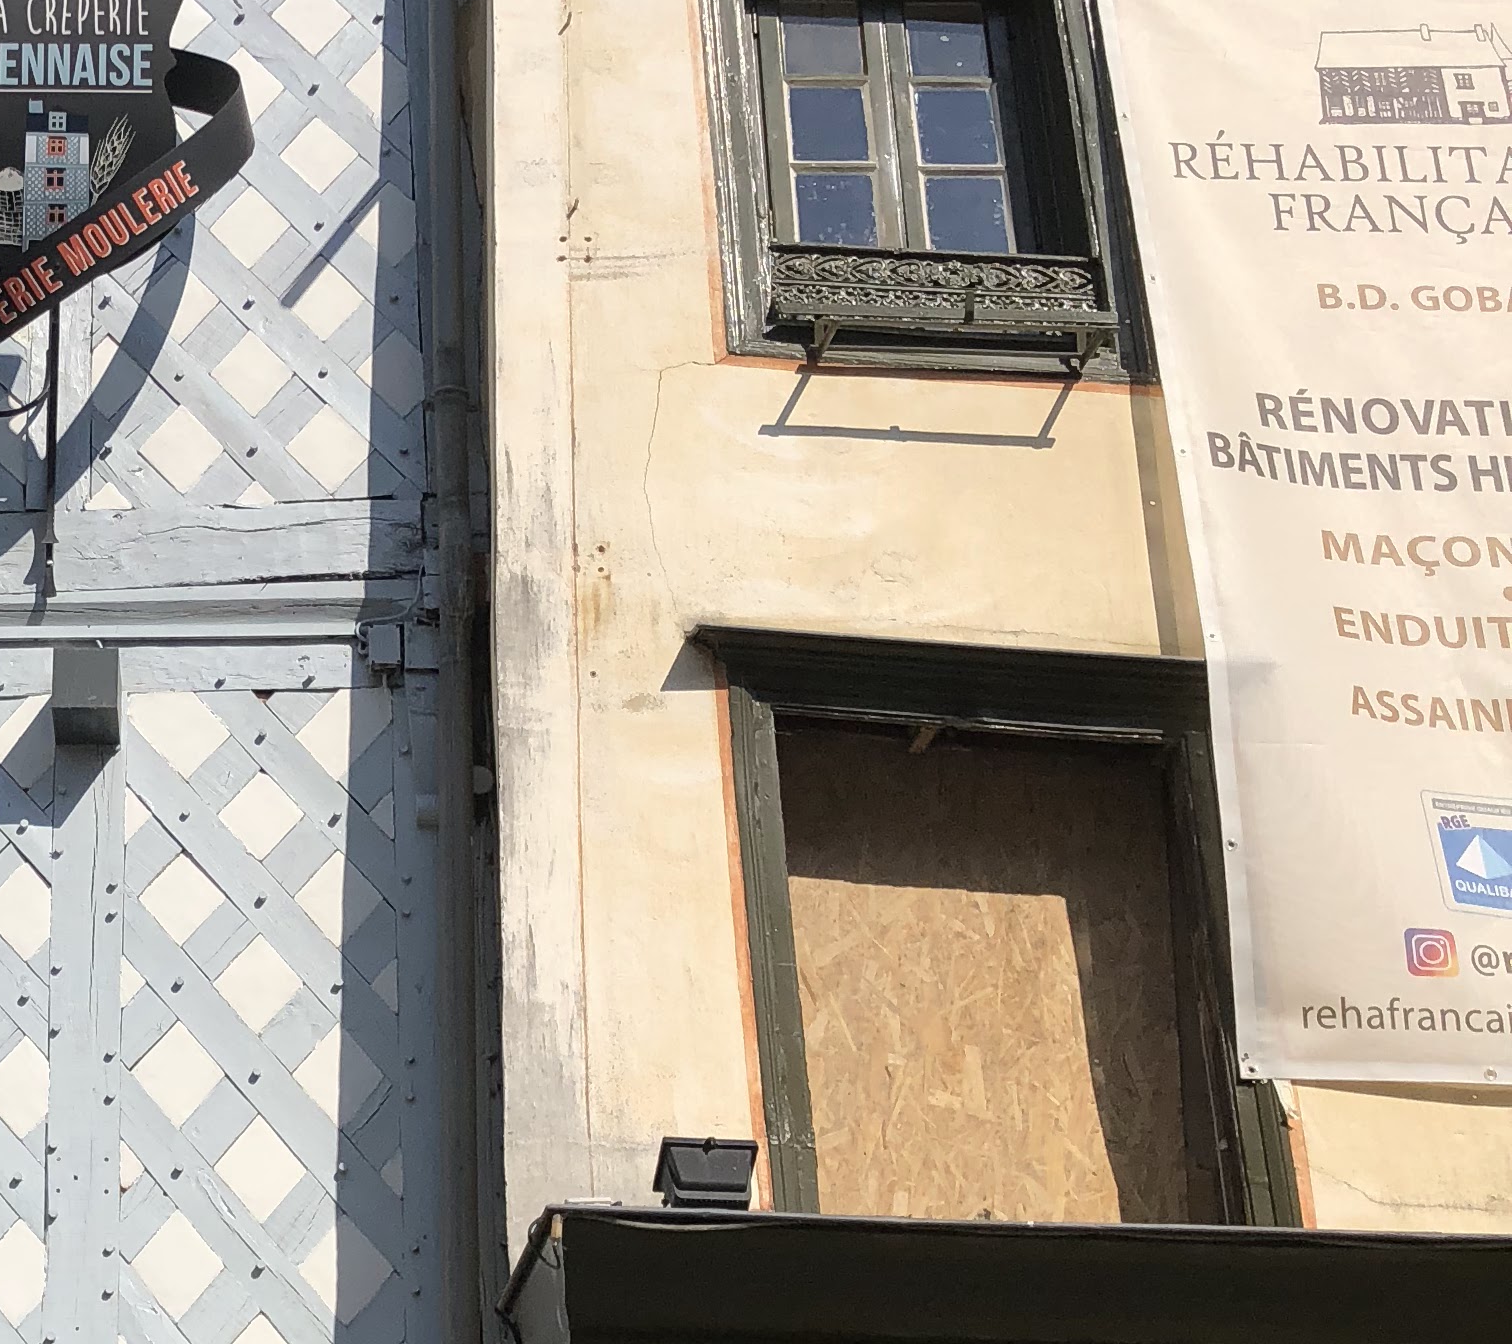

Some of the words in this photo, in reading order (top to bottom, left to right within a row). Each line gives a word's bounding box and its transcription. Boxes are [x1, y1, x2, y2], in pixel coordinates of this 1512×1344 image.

[56, 159, 200, 277] MOULERIE
[1268, 192, 1512, 245] FRANÇA
[1316, 283, 1400, 311] B.D.
[1410, 284, 1512, 313] GOB
[1206, 431, 1458, 492] BÂTIMENTS
[1333, 606, 1512, 649] ENDUIT
[1440, 814, 1471, 830] RGE
